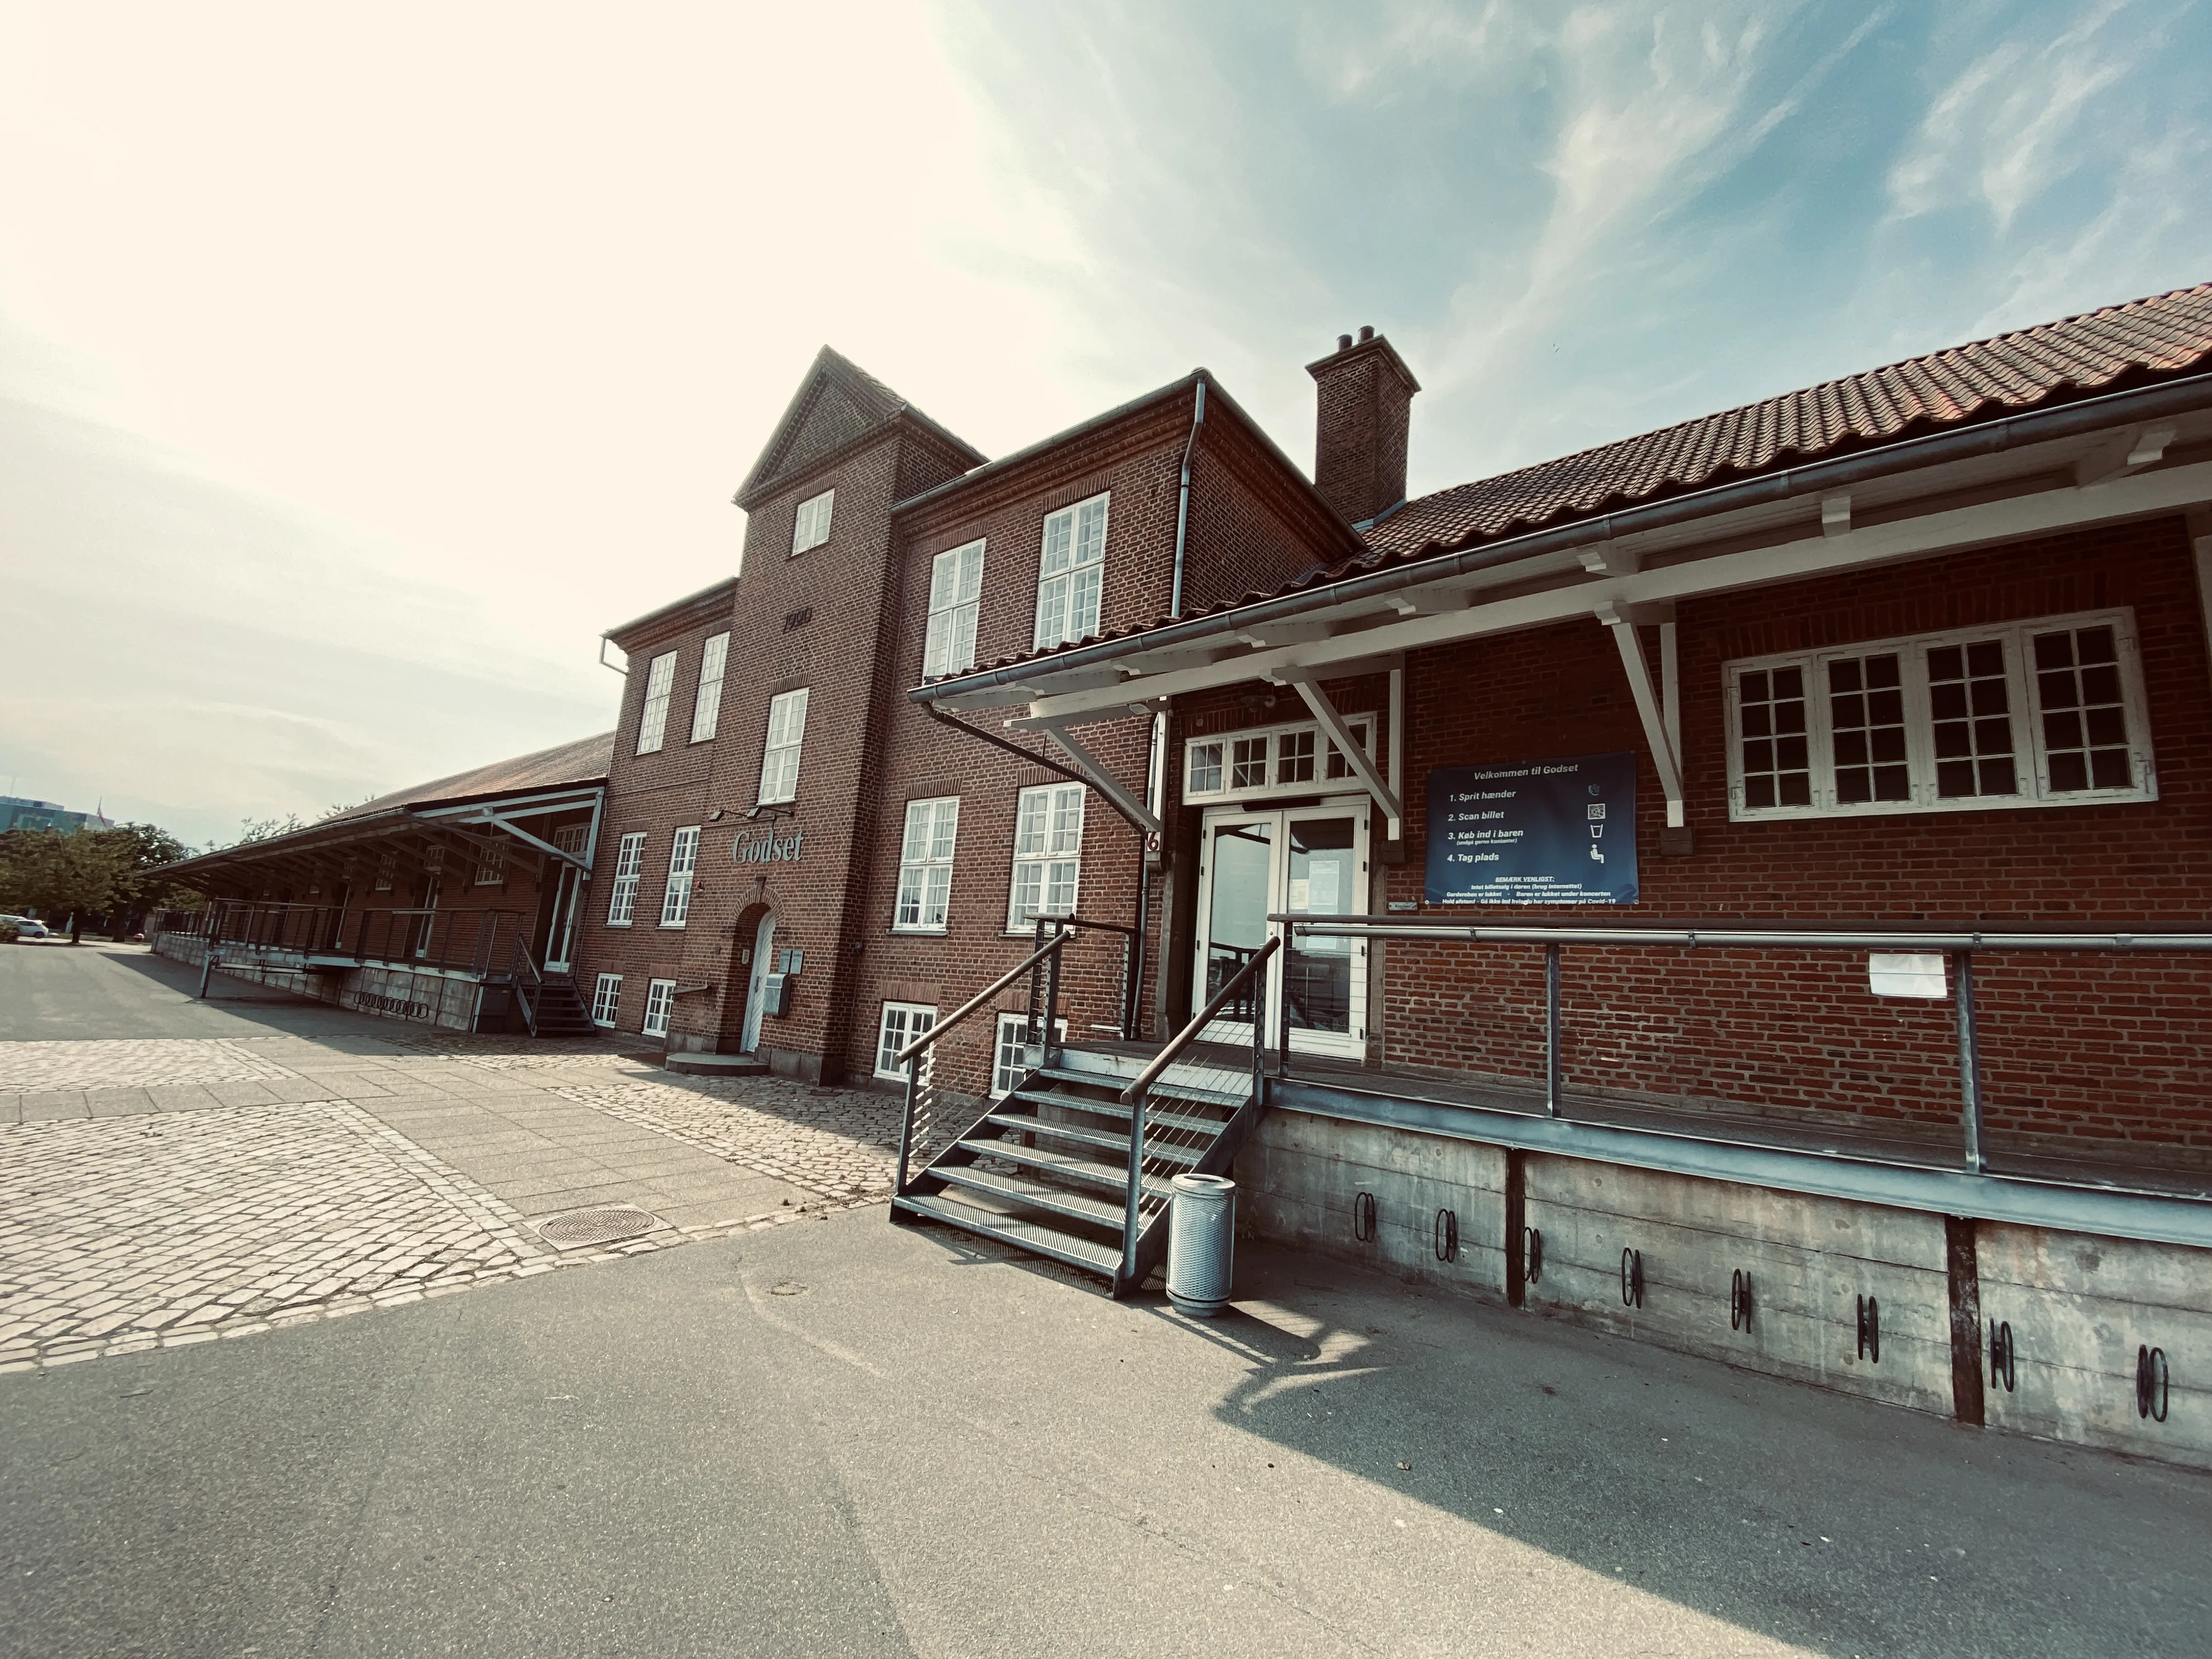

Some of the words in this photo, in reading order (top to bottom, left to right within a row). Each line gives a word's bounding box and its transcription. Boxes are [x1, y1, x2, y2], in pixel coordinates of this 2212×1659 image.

[1474, 769, 1528, 780] Velkommen
[1531, 766, 1541, 775] til
[1543, 764, 1578, 774] Godset
[1459, 792, 1480, 802] Sprit
[1481, 789, 1516, 799] hænder
[1481, 811, 1504, 819] billet
[1147, 831, 1159, 851] 6
[1448, 832, 1455, 840] 3.
[1458, 831, 1475, 839] Køb
[1476, 830, 1491, 838] ind
[1493, 830, 1497, 838] i
[1498, 830, 1523, 838] baren
[732, 829, 804, 864] Godset
[1447, 854, 1455, 862] 4.
[1458, 854, 1473, 863] Tag
[1474, 853, 1499, 863] plads
